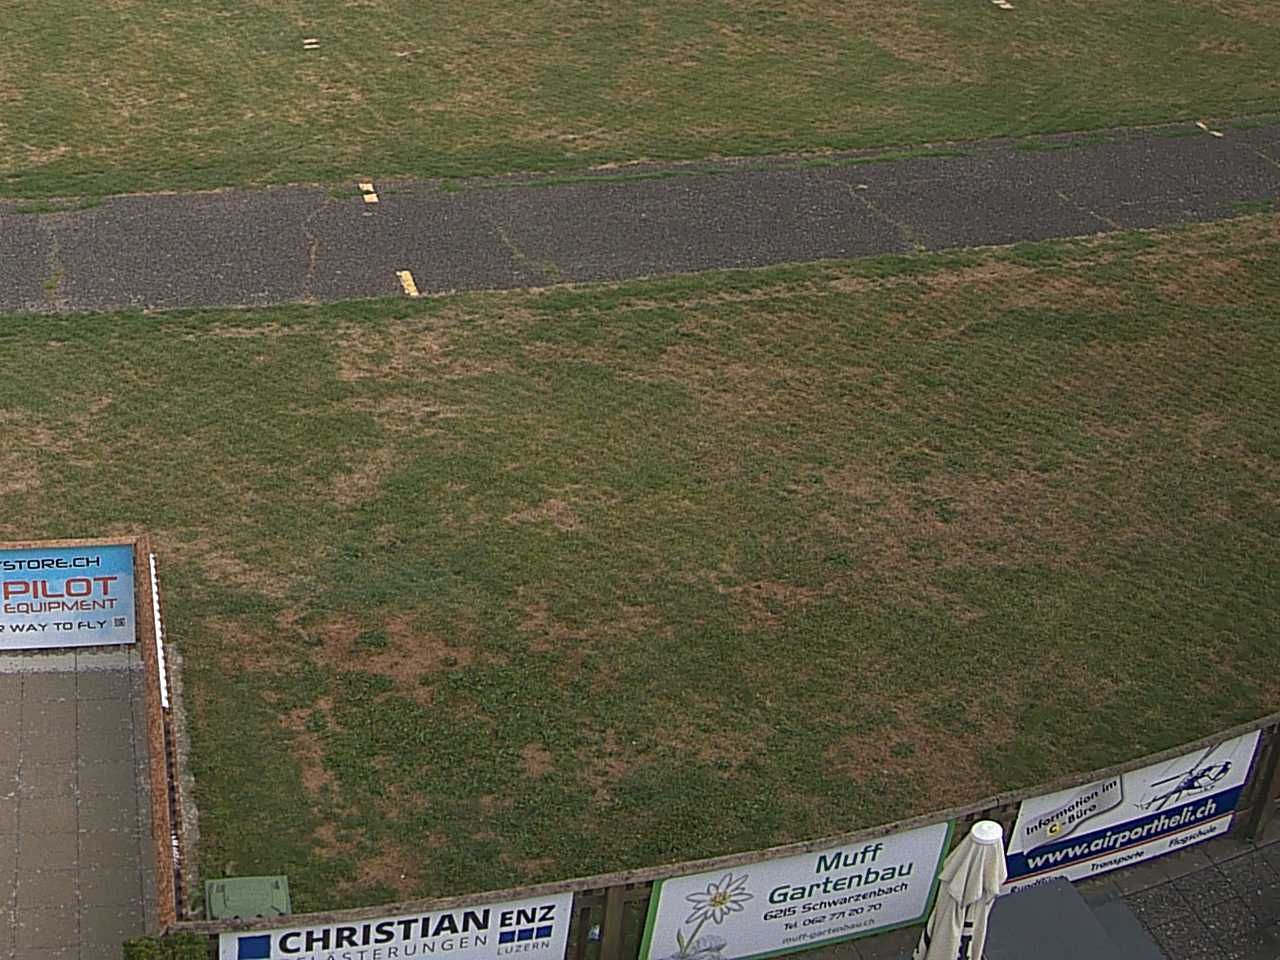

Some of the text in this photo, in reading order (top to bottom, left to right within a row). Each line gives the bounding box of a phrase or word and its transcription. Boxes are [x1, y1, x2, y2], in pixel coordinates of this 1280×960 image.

[2, 576, 117, 600] PILOT
[4, 598, 117, 614] EQUIPMENT
[12, 623, 48, 633] WAY
[53, 622, 73, 631] TO
[78, 619, 107, 630] FLY
[1026, 780, 1117, 836] Information im
[1027, 800, 1217, 870] www.airportheli.ch
[816, 843, 883, 874] Muff
[768, 862, 913, 905] Gartenbau
[763, 882, 908, 921] 6215 Schwarzenbach
[802, 915, 826, 927] 062
[848, 907, 864, 917] 20
[867, 903, 882, 912] 70
[278, 904, 556, 954] CHRISTIAN ENZ
[497, 940, 550, 956] LUZERN
